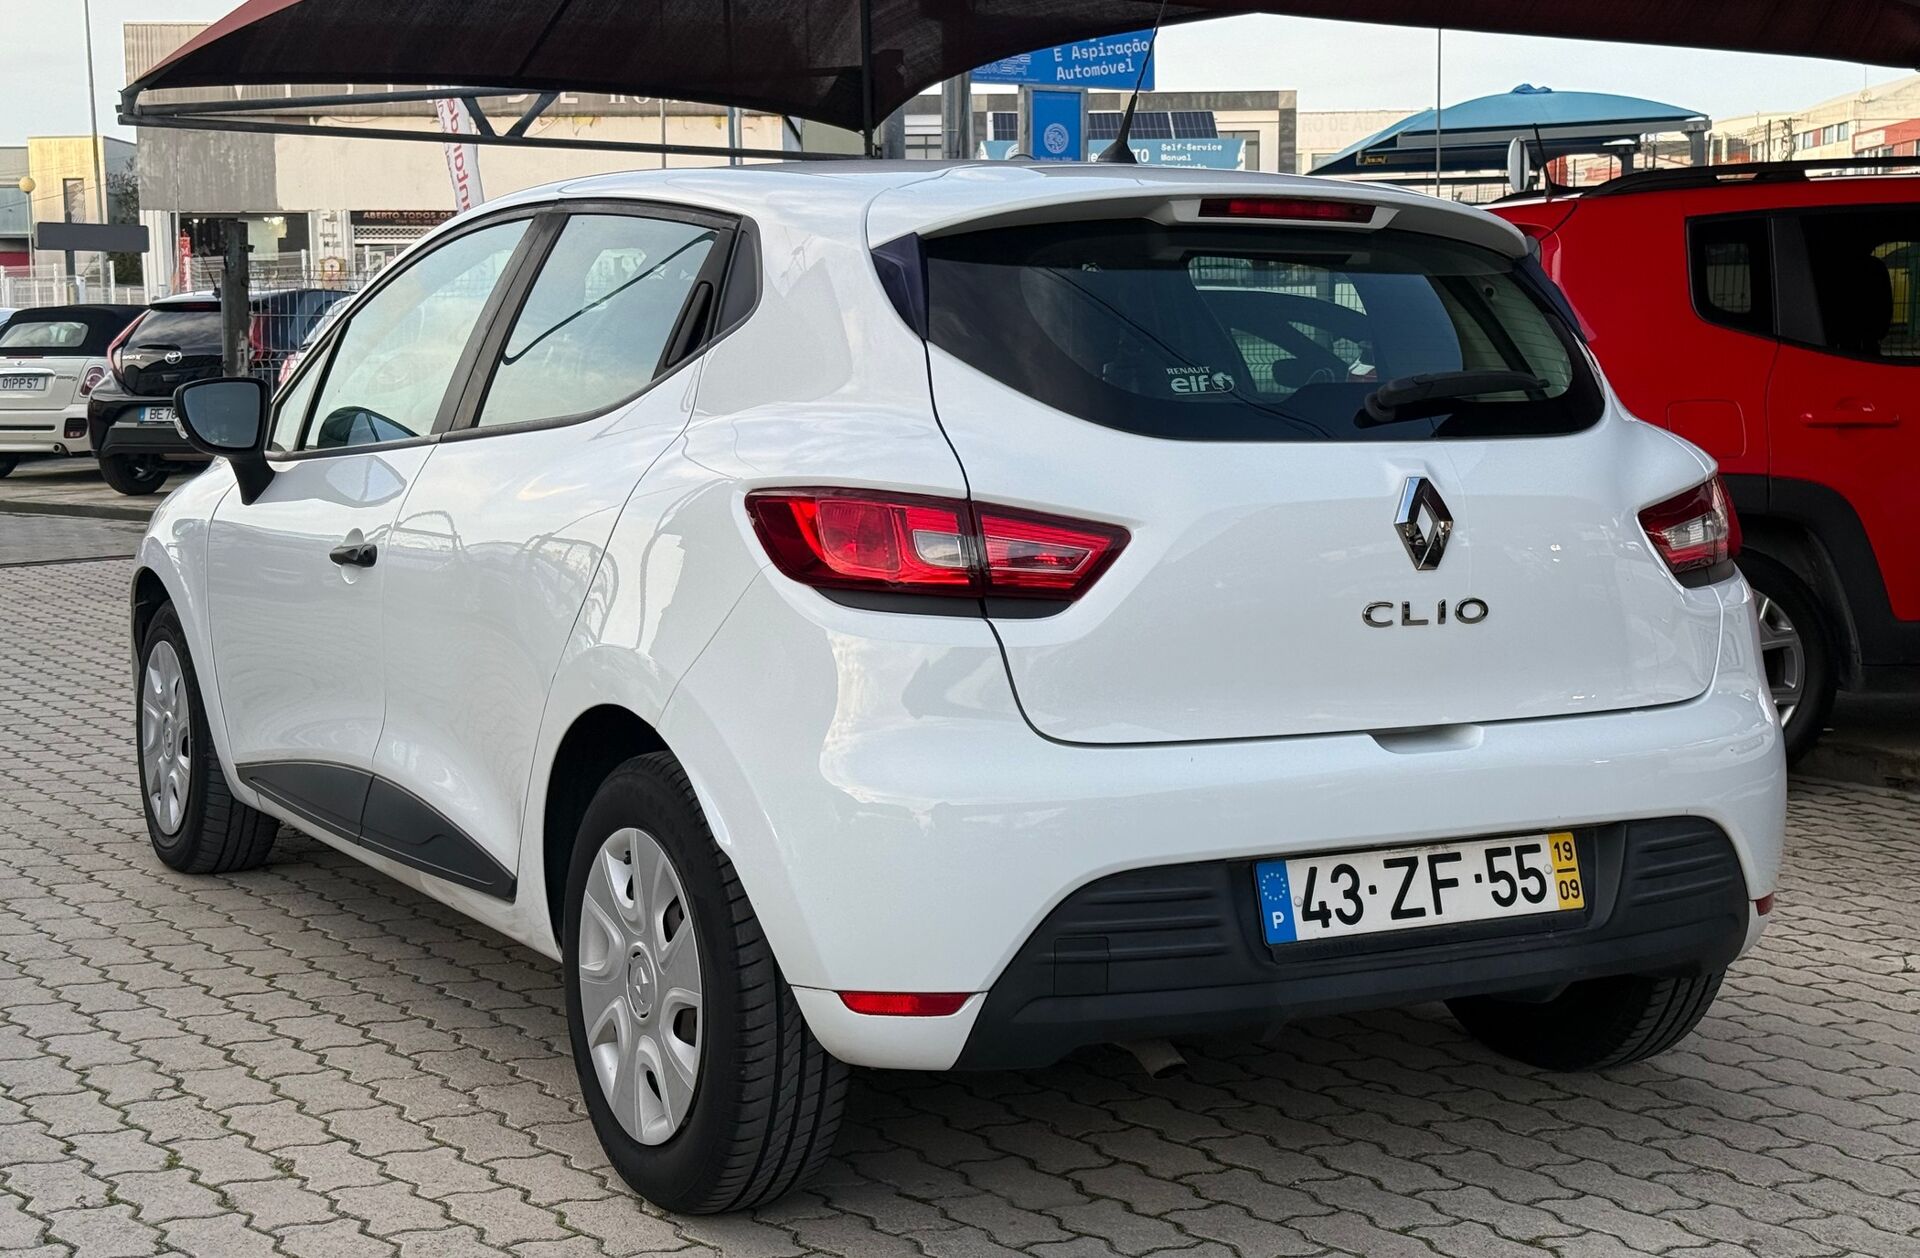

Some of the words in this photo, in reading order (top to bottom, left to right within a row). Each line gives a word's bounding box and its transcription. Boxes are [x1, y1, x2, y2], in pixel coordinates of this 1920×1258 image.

[1053, 48, 1063, 62] E
[1071, 38, 1149, 62] Aspiração
[1056, 58, 1135, 81] Automóvel
[1160, 143, 1222, 152] Self-Service
[1160, 153, 1191, 162] Manual
[363, 211, 400, 220] ABERTO
[403, 211, 436, 220] TODOS
[439, 211, 453, 220] OS
[1166, 366, 1211, 375] RENAULT
[1170, 374, 1210, 392] elf
[1362, 597, 1489, 628] CLIO
[1553, 841, 1574, 862] 19
[1559, 879, 1581, 901] 09
[1272, 911, 1285, 930] P
